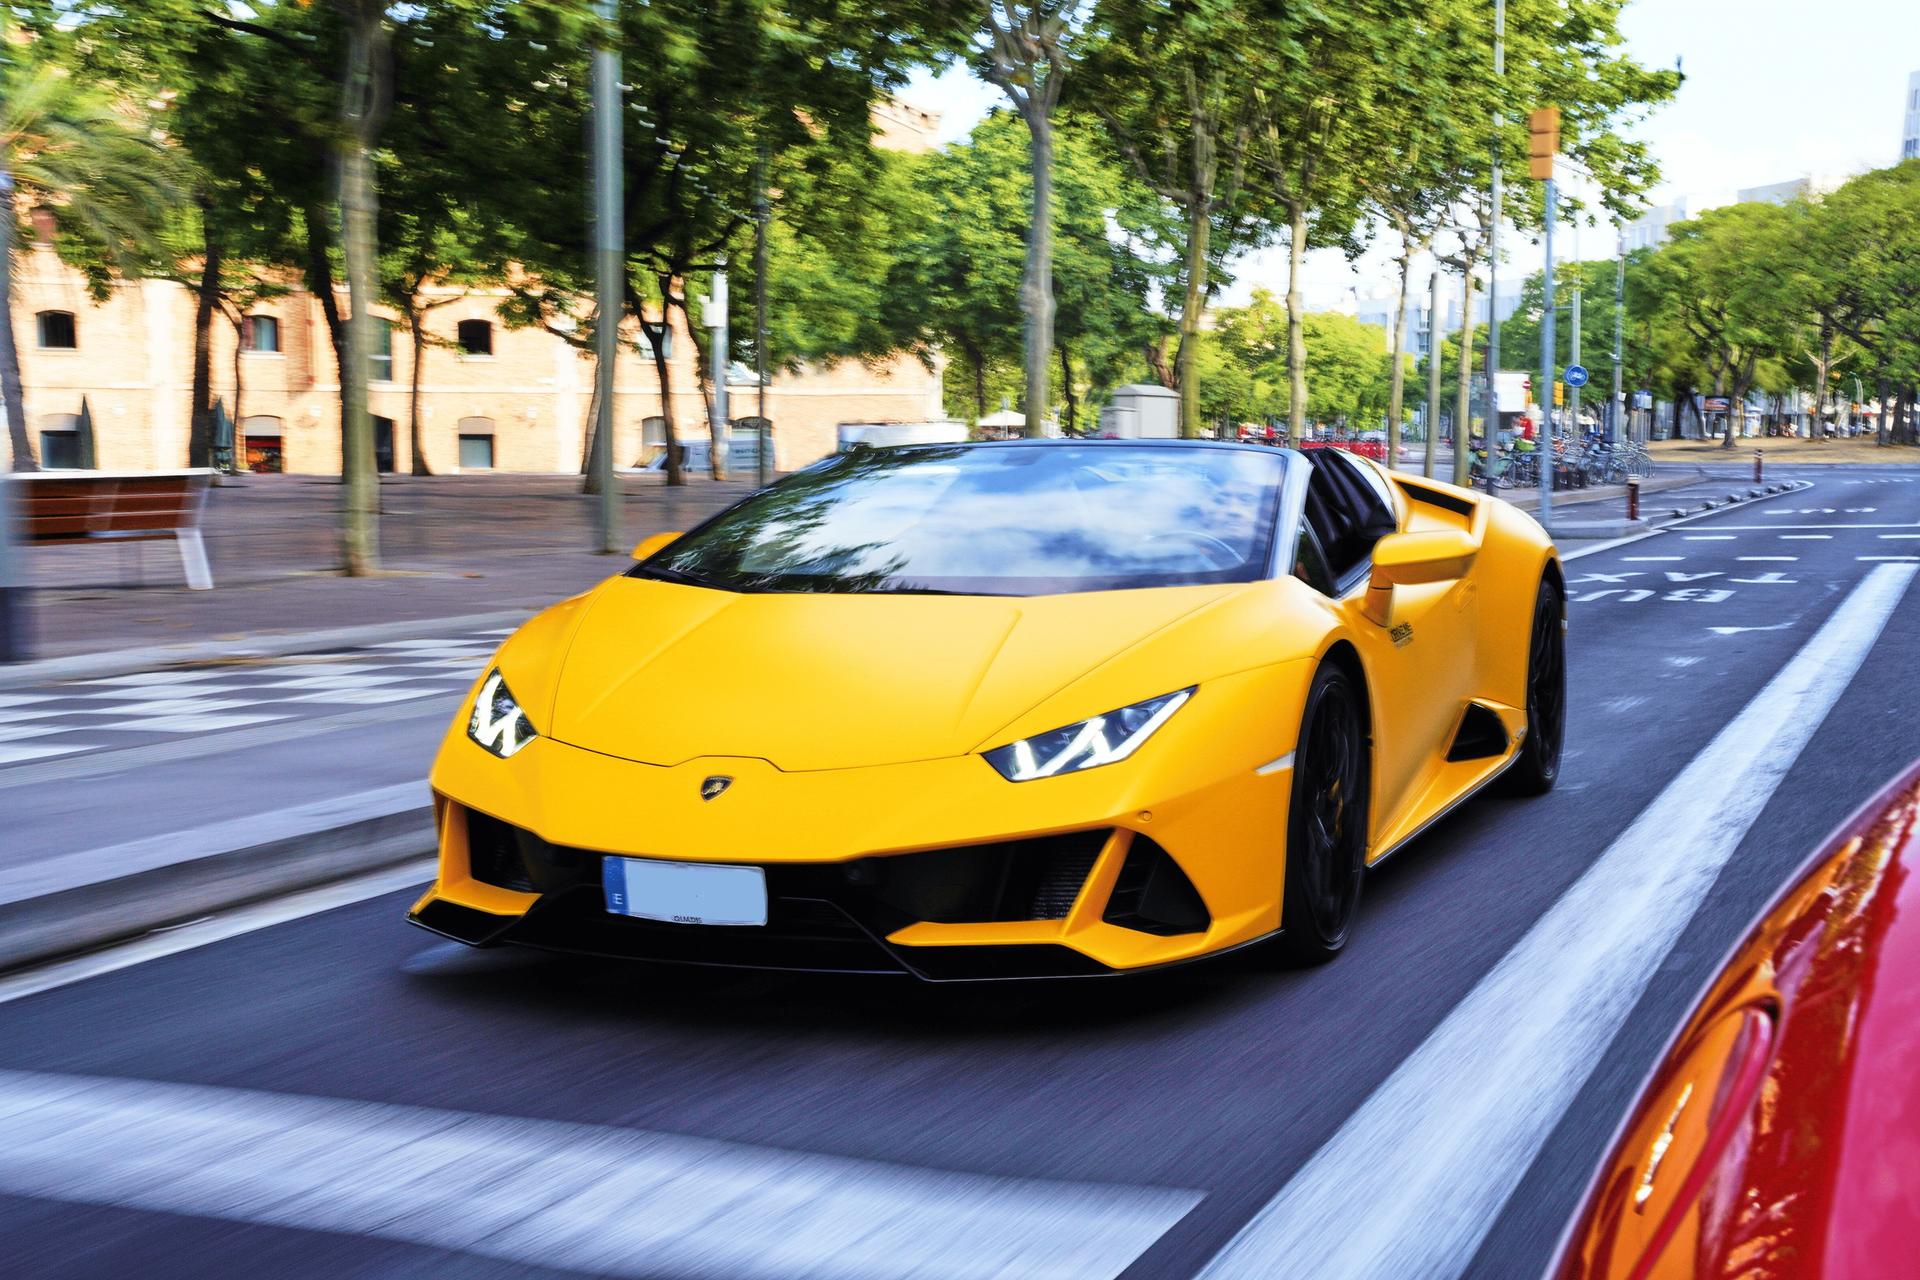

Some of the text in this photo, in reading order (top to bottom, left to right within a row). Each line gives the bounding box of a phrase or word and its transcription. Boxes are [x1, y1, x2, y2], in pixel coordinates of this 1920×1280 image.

[1565, 571, 1799, 584] TAX
[1564, 588, 1738, 603] BU
[612, 892, 624, 906] E
